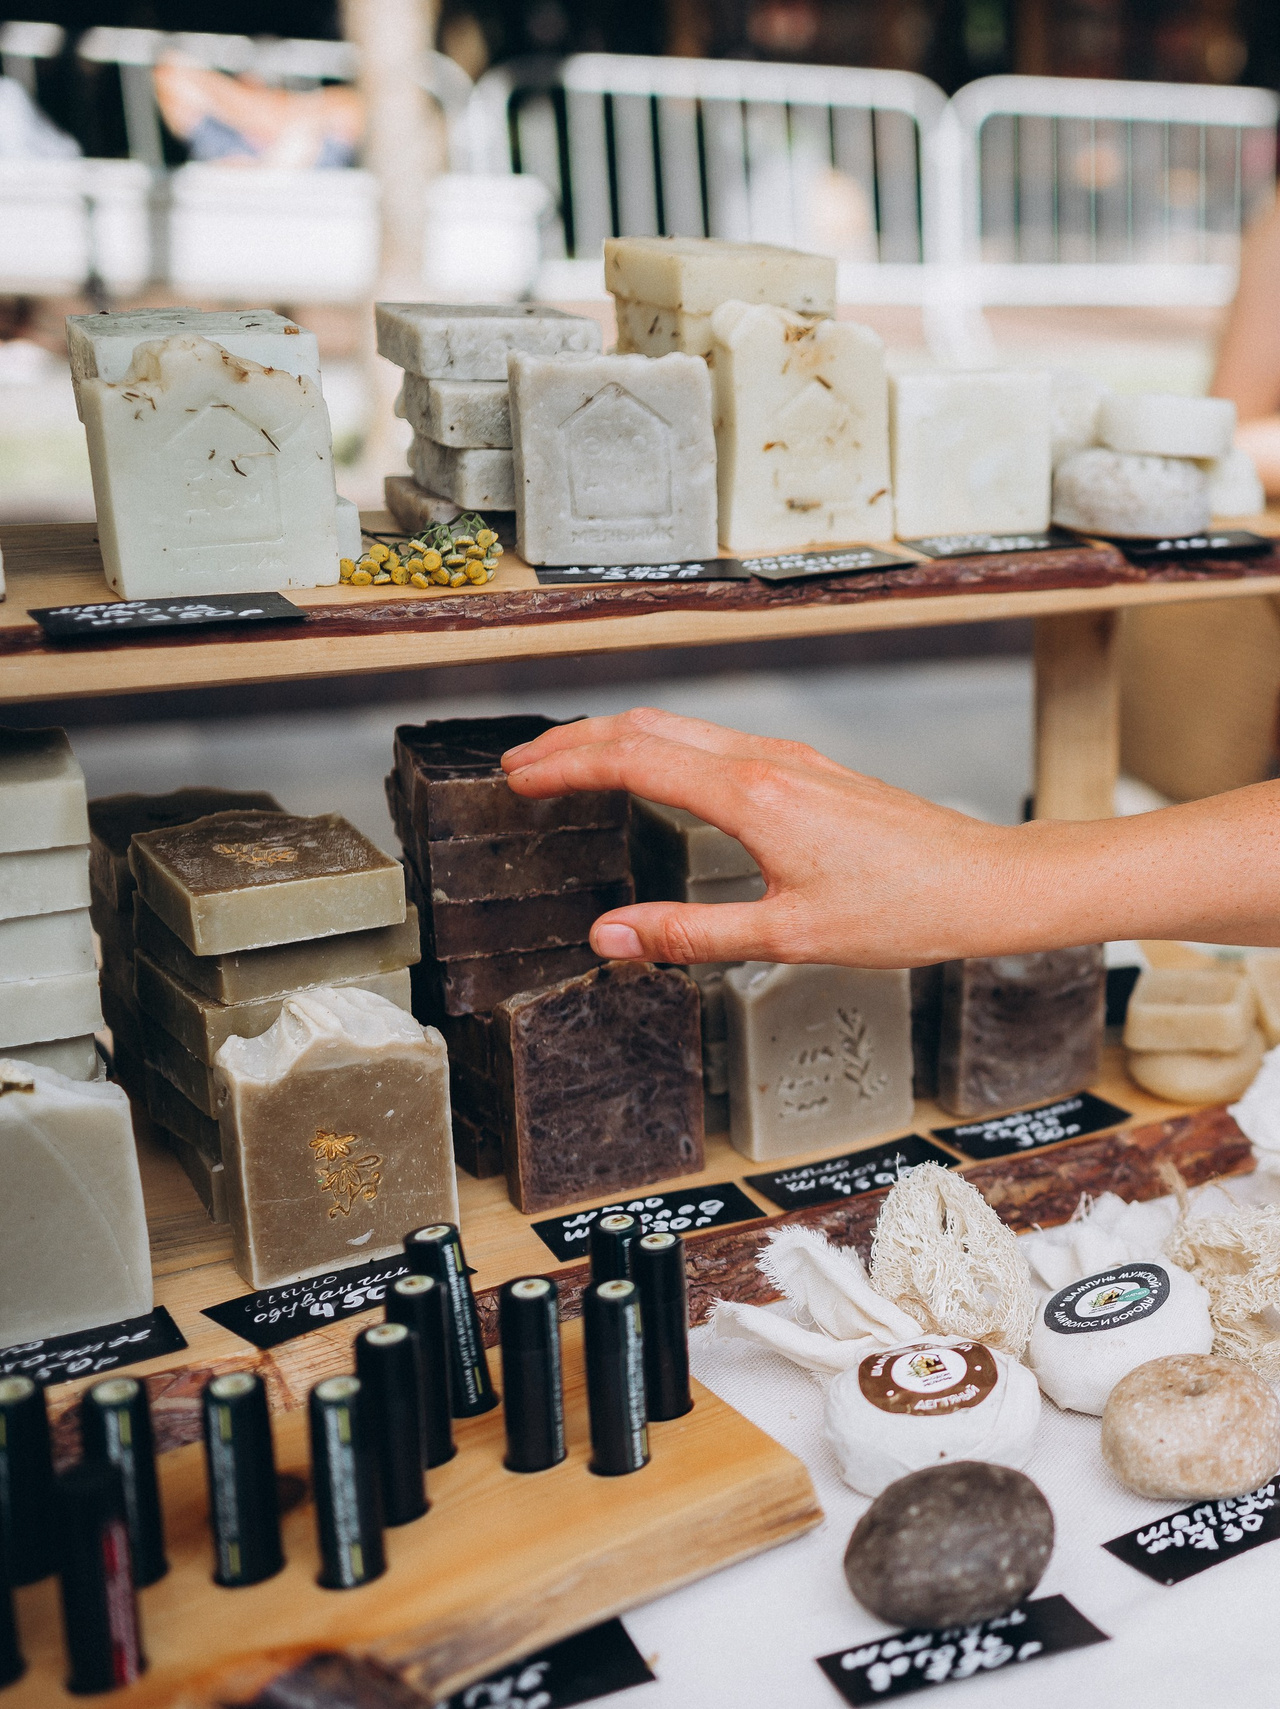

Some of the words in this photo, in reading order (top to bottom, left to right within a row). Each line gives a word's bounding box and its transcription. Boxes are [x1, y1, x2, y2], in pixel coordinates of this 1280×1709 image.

[1062, 1275, 1116, 1302] ШАМПУНЬ
[1118, 1270, 1162, 1288] МУЖСКОЙ
[1063, 1317, 1099, 1328] ВОЛОС
[1112, 1296, 1155, 1323] БОРОДЫ
